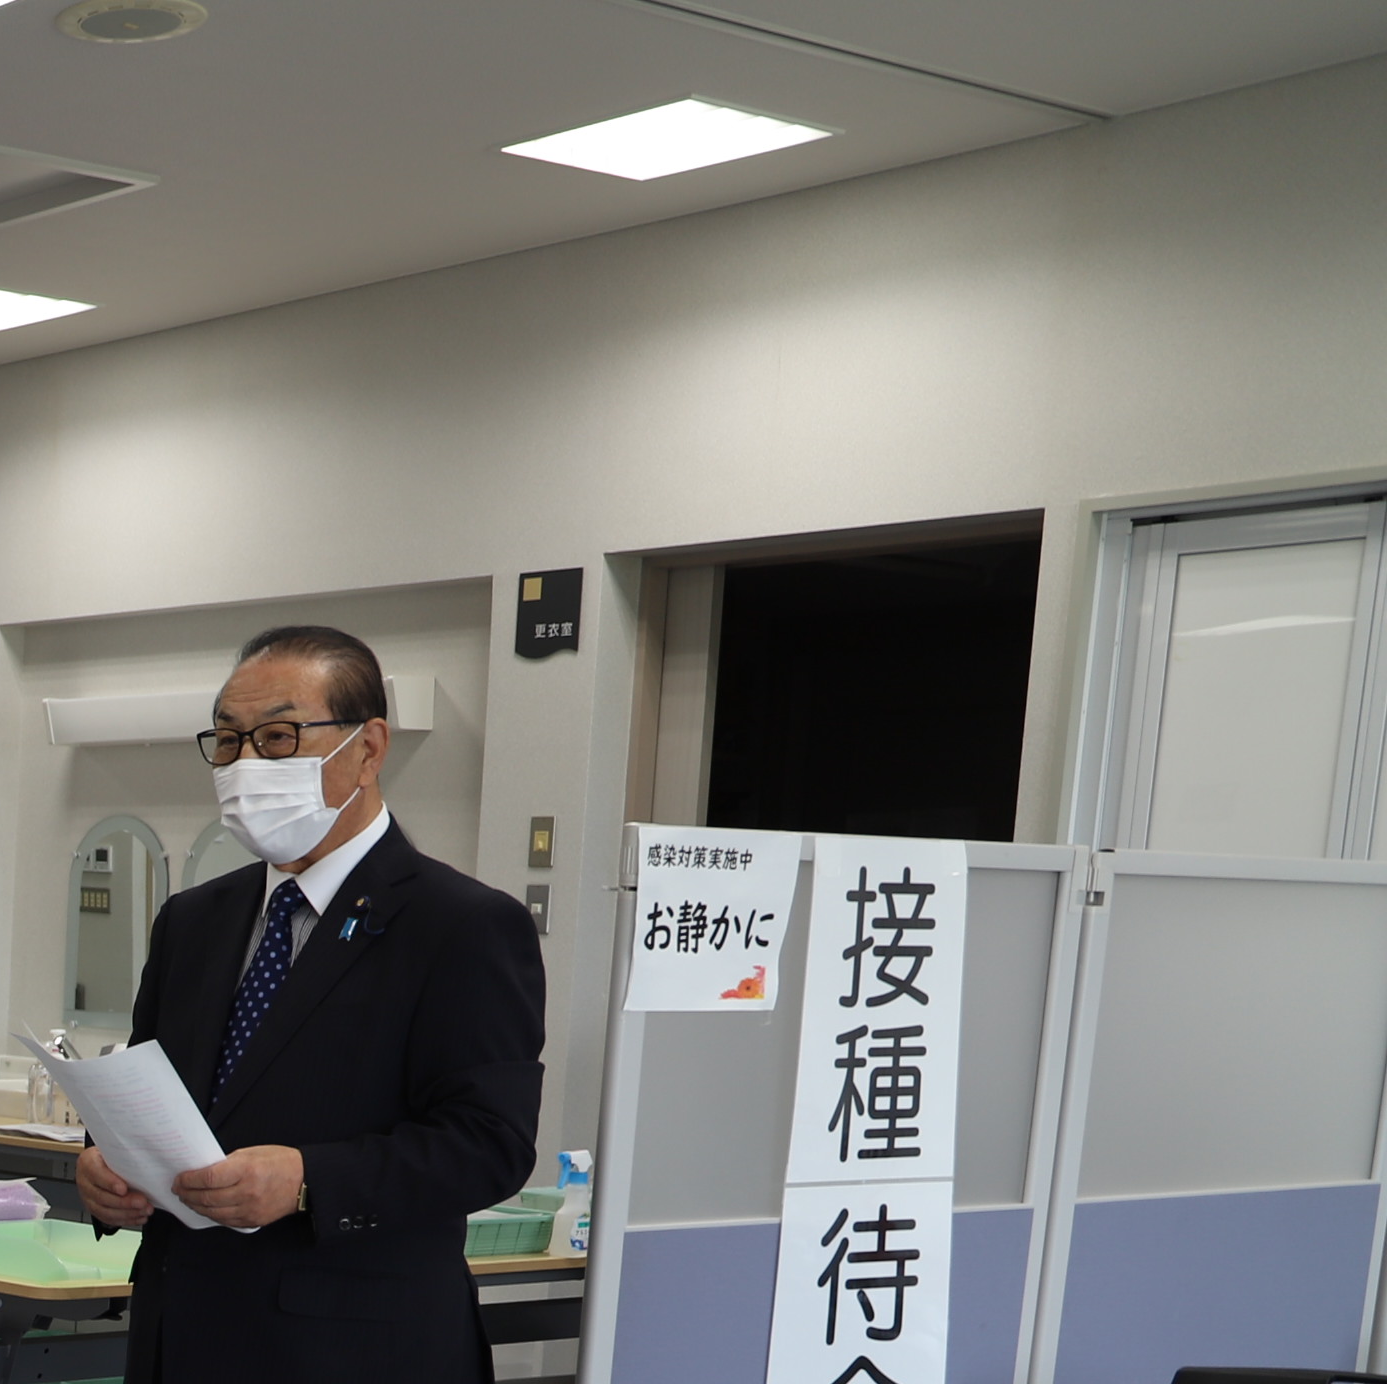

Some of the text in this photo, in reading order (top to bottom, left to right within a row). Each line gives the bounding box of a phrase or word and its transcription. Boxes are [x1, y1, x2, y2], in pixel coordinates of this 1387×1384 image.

[534, 622, 573, 638] 更衣室
[647, 844, 753, 871] 感染対策実施中
[644, 900, 775, 953] お静かに
